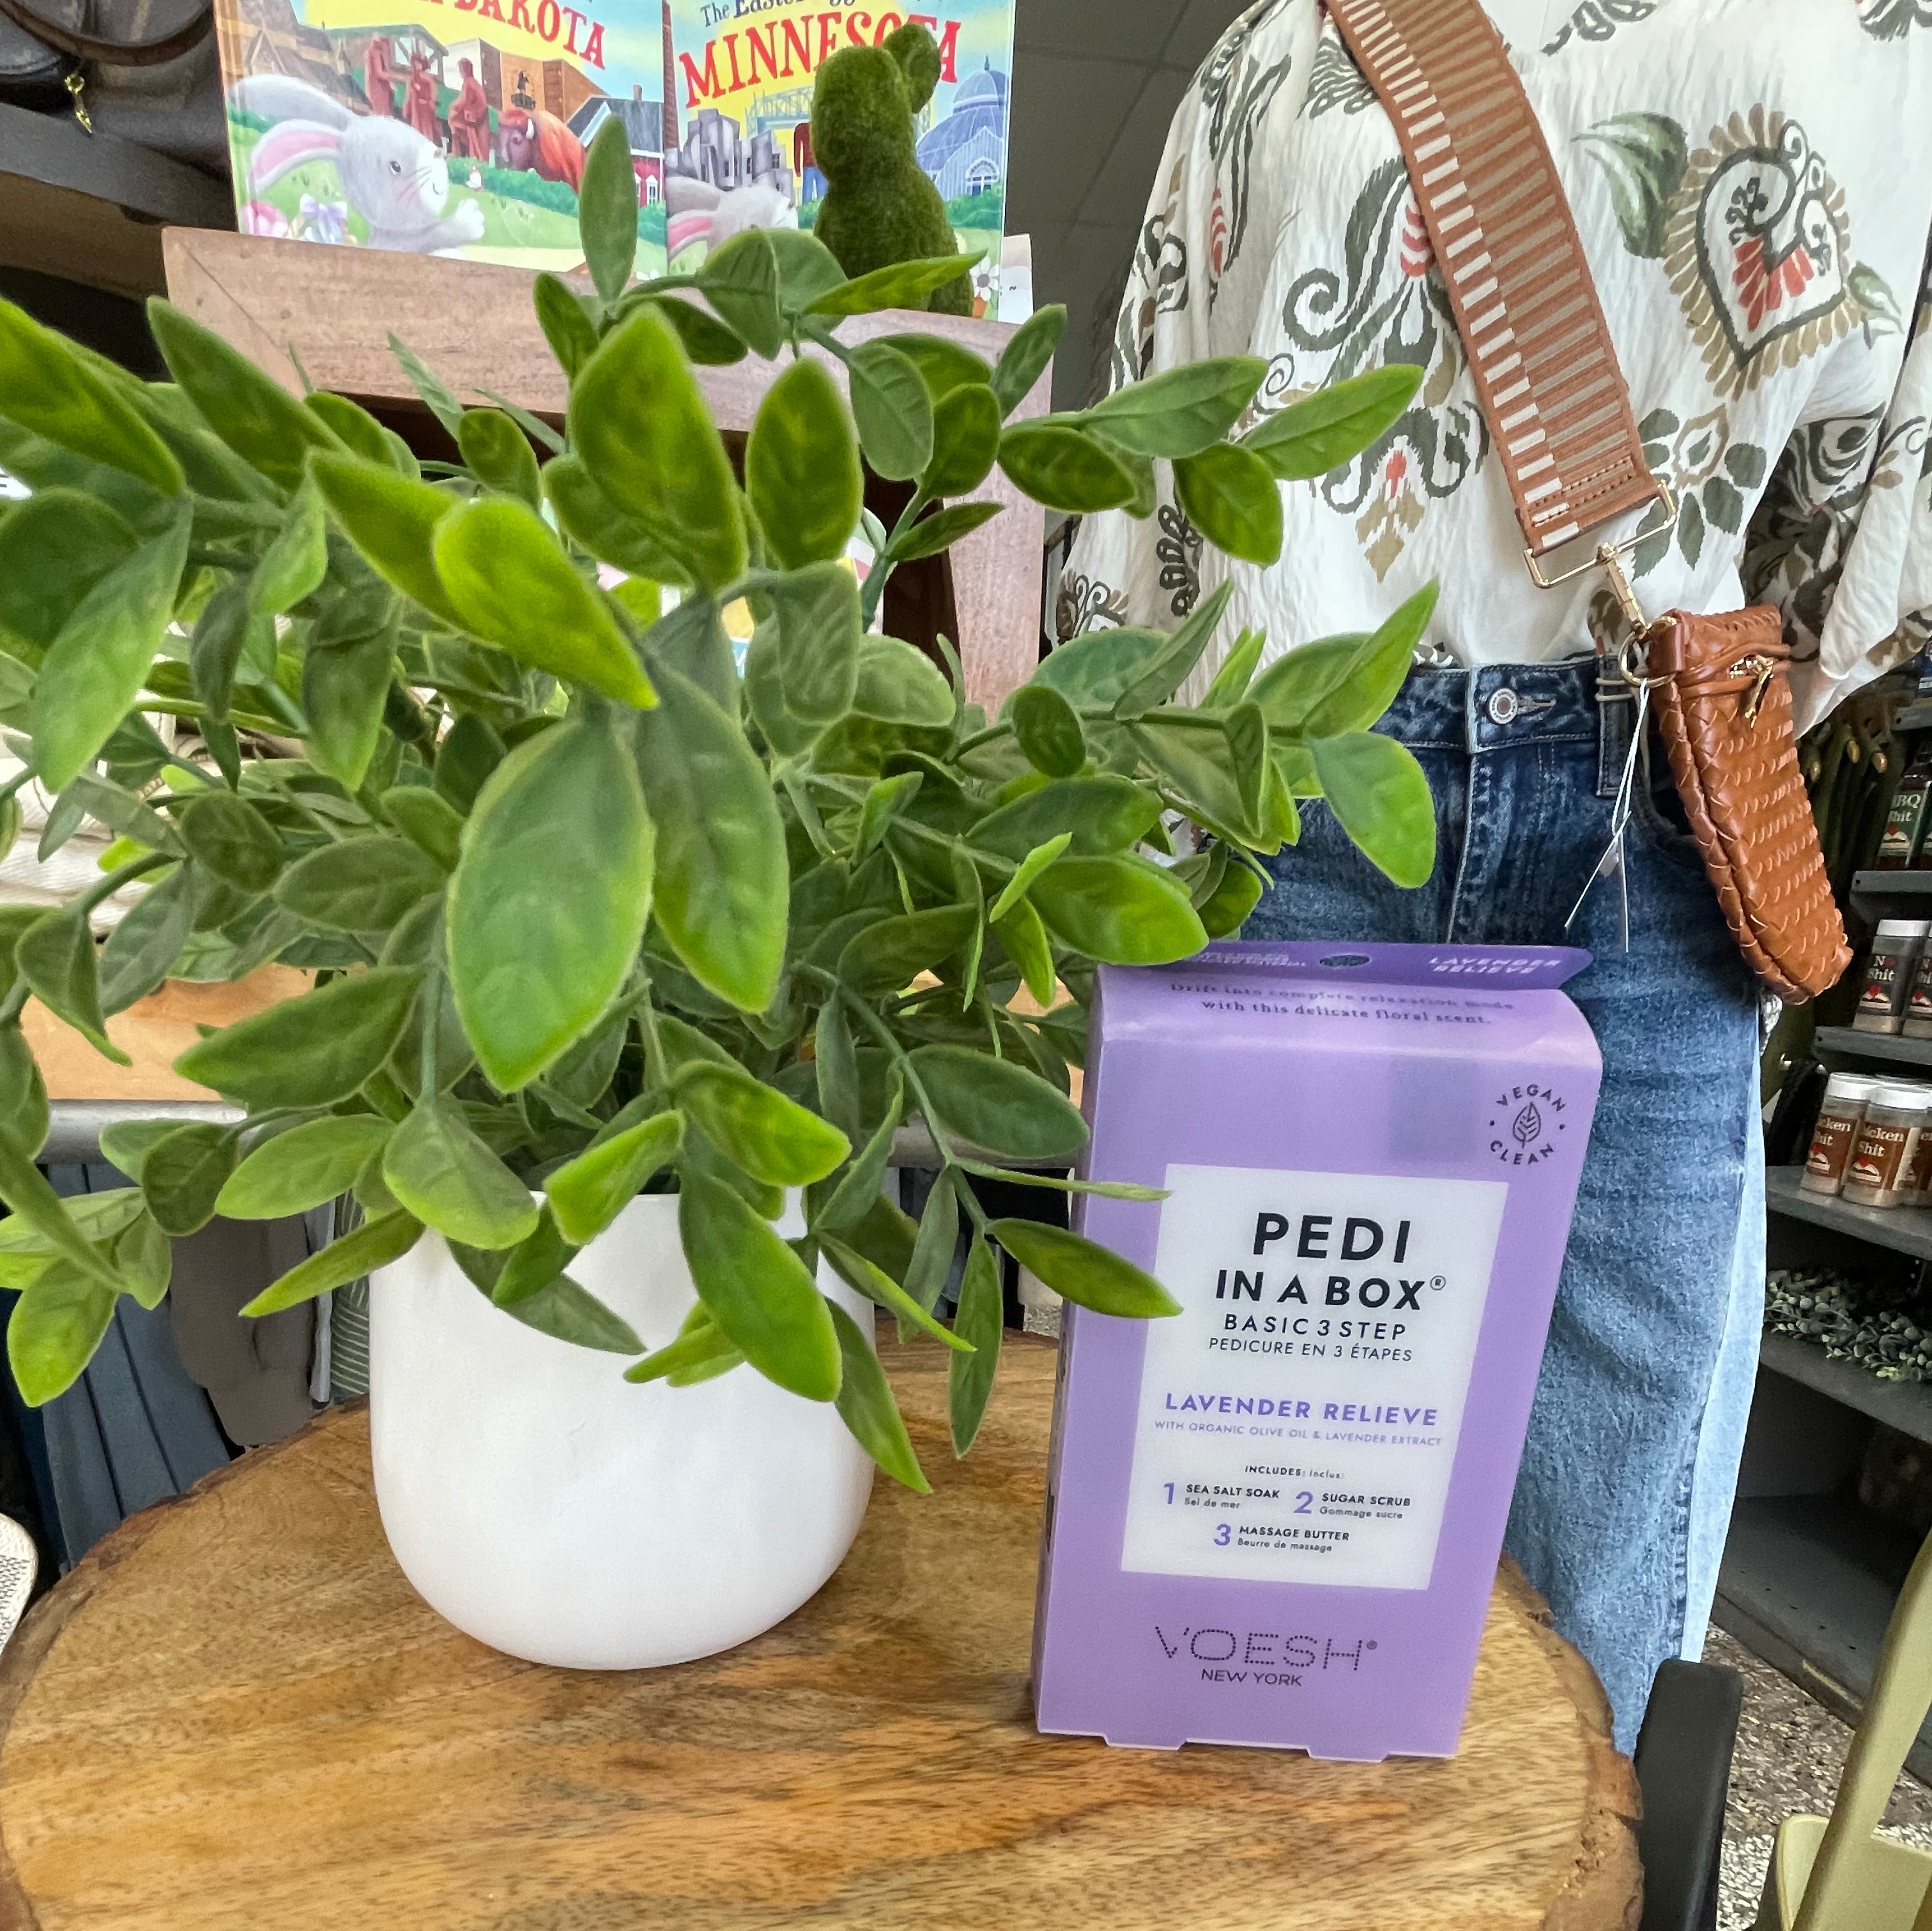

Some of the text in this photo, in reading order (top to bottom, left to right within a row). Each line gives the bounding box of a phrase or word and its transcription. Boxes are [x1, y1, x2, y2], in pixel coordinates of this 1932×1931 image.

[700, 2, 730, 27] The
[454, 0, 606, 70] AKOTA
[678, 11, 961, 109] MINNESA
[1201, 1000, 1245, 1011] with
[1252, 1002, 1289, 1014] this
[1294, 1004, 1368, 1018] delicate
[1376, 1009, 1429, 1021] floral
[1496, 1083, 1566, 1112] VEGAN
[1489, 1140, 1554, 1165] CLEAN
[1253, 1212, 1411, 1263] PEDI
[1215, 1269, 1264, 1302] IN
[1276, 1274, 1308, 1305] A
[1224, 1313, 1406, 1341] BASIC 3 STEP
[1209, 1337, 1413, 1362] PEDICURE EN 3 ÉTAPES
[1165, 1393, 1438, 1426] LAVENDER RELIEVE
[1154, 1420, 1441, 1447] WITH ORGANIC OLIVE OIL & LAVENDER EXTRACT
[1163, 1482, 1280, 1505] 1 SEA SALT SOAK
[1293, 1491, 1411, 1514] 2 SUGAR SCRUB
[1319, 1506, 1372, 1519] Gommage
[1213, 1523, 1350, 1546] 3 MASSAGE BUTTER
[1237, 1537, 1270, 1548] Beurre
[1290, 1542, 1333, 1553] massage
[1200, 1668, 1304, 1687] NEW YORK
